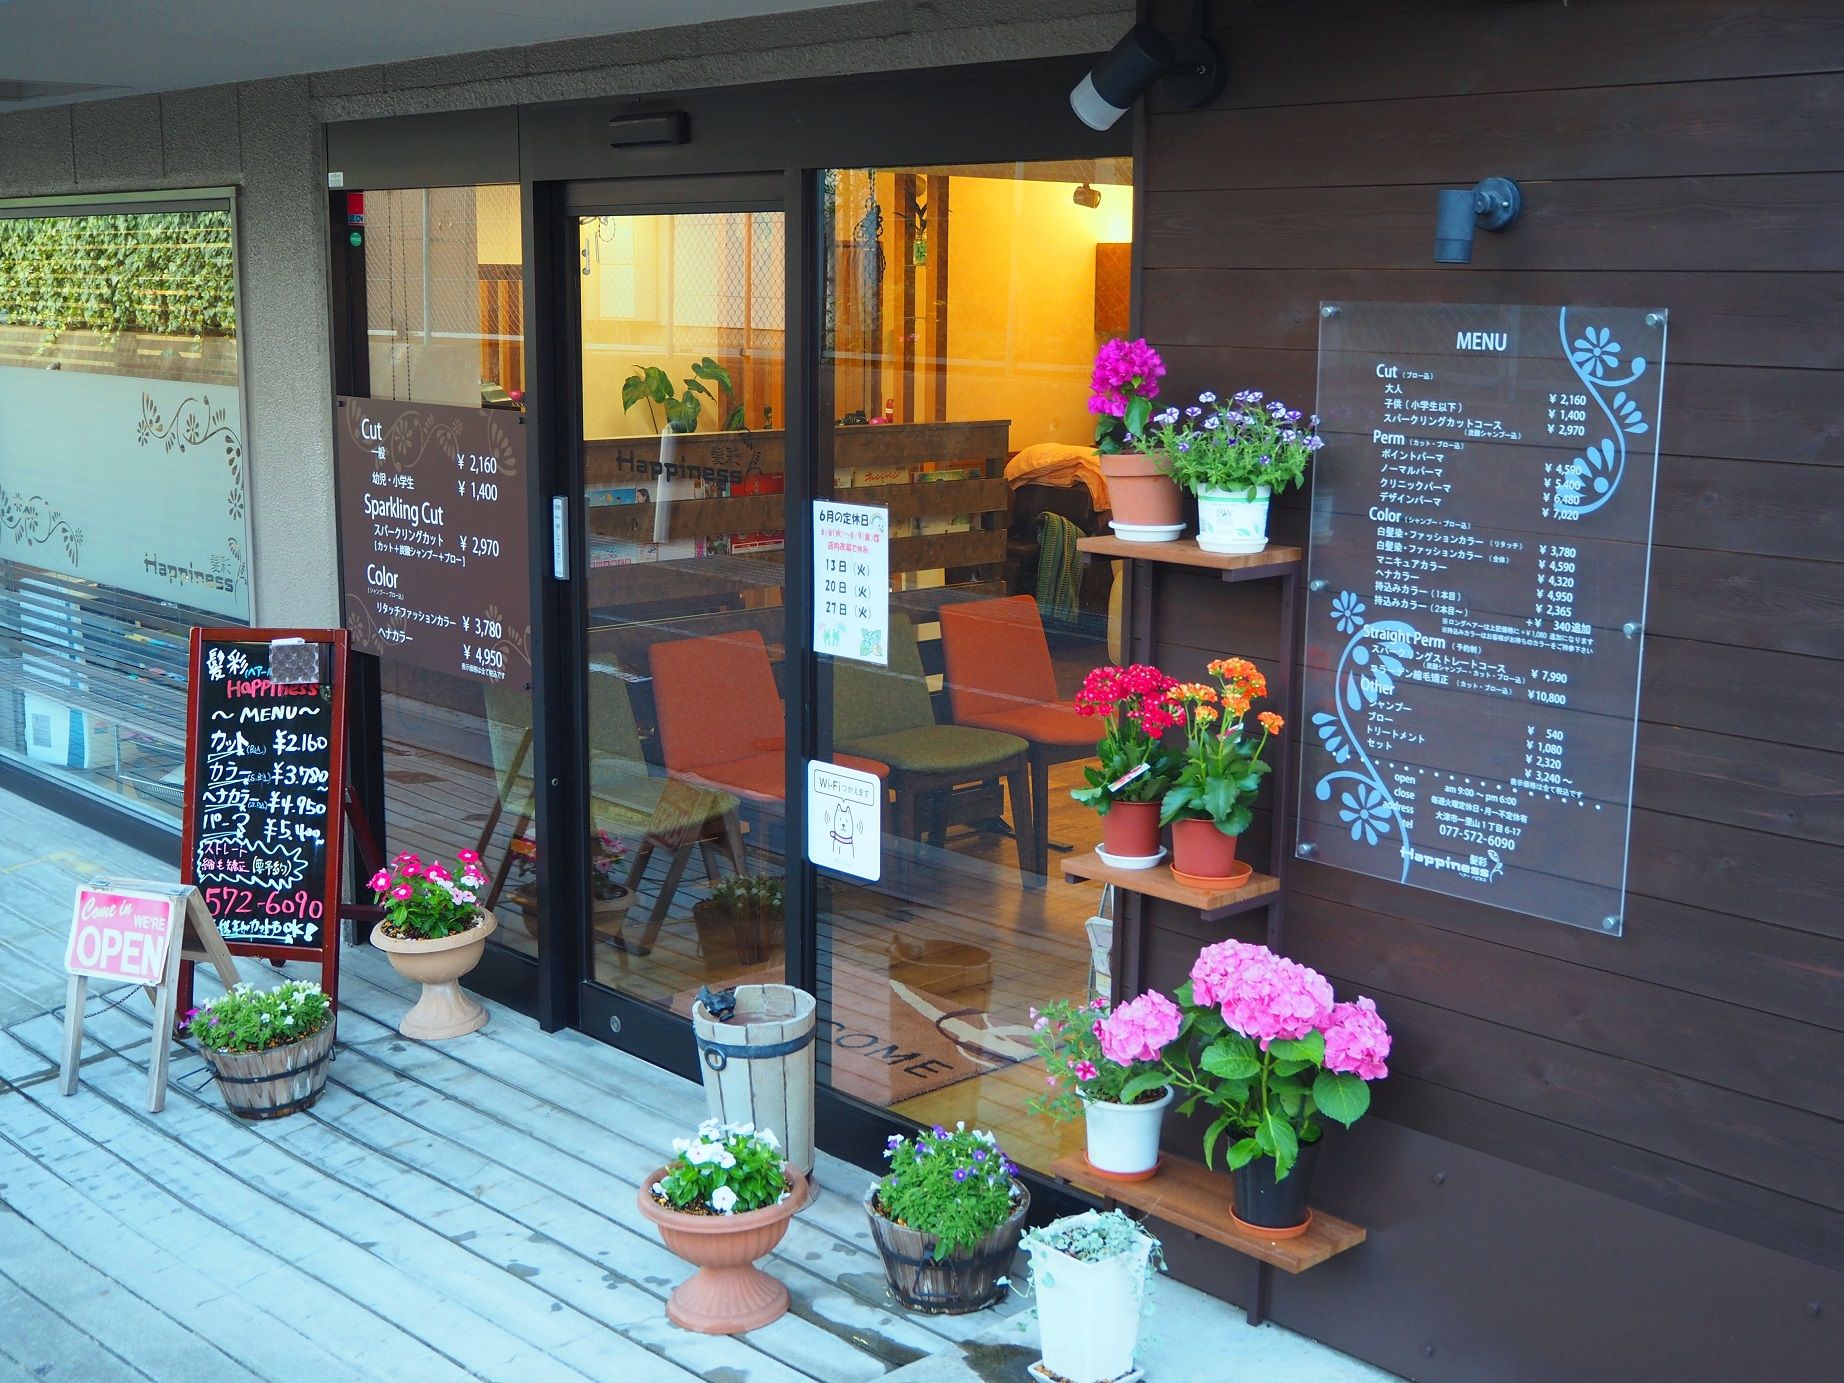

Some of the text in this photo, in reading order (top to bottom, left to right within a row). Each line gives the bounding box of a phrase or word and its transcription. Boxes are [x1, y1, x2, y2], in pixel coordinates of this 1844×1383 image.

[1456, 332, 1508, 352] MENU
[1376, 363, 1399, 379] Cut
[1384, 383, 1403, 394] 大人
[1560, 394, 1587, 406] 2,160
[1383, 413, 1503, 430] スパークリングカットコース
[1559, 409, 1587, 422] 1,400
[361, 417, 383, 442] Cut
[1373, 429, 1406, 446] Perm
[1558, 424, 1586, 437] 2,970
[1381, 448, 1445, 463] ポイントパーマ
[469, 454, 498, 475] 2,160
[616, 449, 743, 484] Happiness
[1380, 463, 1443, 478] ノーマルパーマ
[470, 481, 499, 502] 1,400
[1380, 477, 1453, 493] クリニックパーマ
[1379, 491, 1442, 507] デザインパーマ
[363, 493, 444, 528] Sparkling Cut
[819, 509, 870, 527] 6月の定休日
[1368, 506, 1402, 523] Color
[374, 523, 445, 548] スパークリングカット
[472, 536, 500, 558] 2,970
[1550, 545, 1577, 559] 3,780
[825, 558, 847, 573] 13日
[1376, 555, 1448, 571] マニキュアカラー
[1549, 560, 1576, 574] 4,590
[143, 551, 234, 593] Happiness
[367, 563, 399, 590] Color
[1375, 568, 1421, 582] ヘナカラー
[825, 579, 847, 594] 20日
[1548, 575, 1575, 588] 4,320
[1547, 590, 1574, 603] 4,950
[376, 601, 457, 628] リタッチファッションカラー
[825, 601, 847, 616] 27日
[1546, 604, 1573, 618] 2,365
[378, 627, 414, 644] ヘナカラー
[474, 617, 502, 640] 3,780
[1363, 624, 1411, 644] Straight
[1413, 632, 1447, 649] Perm
[475, 646, 504, 669] 4,950
[1542, 670, 1568, 684] 7,990
[1362, 677, 1396, 696] Other
[1527, 689, 1567, 705] ¥10,800
[1368, 712, 1394, 723] ブロー
[1367, 724, 1425, 744] トリートメント
[1545, 728, 1564, 741] 540
[1367, 738, 1392, 751] セット
[1537, 742, 1563, 756] 1,080
[209, 761, 252, 782] カラー
[1536, 756, 1562, 770] 2,320
[1394, 772, 1417, 786] open
[203, 788, 260, 805] ヘナカラー
[1393, 787, 1416, 800] close
[1382, 800, 1415, 815] address
[203, 813, 251, 834] パーマ
[1401, 818, 1516, 852] tel 077-572-6090
[1400, 845, 1490, 879] Happiness
[82, 897, 133, 921] Come in
[206, 887, 324, 919] 572-6090
[134, 914, 166, 931] WE'RE
[76, 925, 165, 978] OPEN
